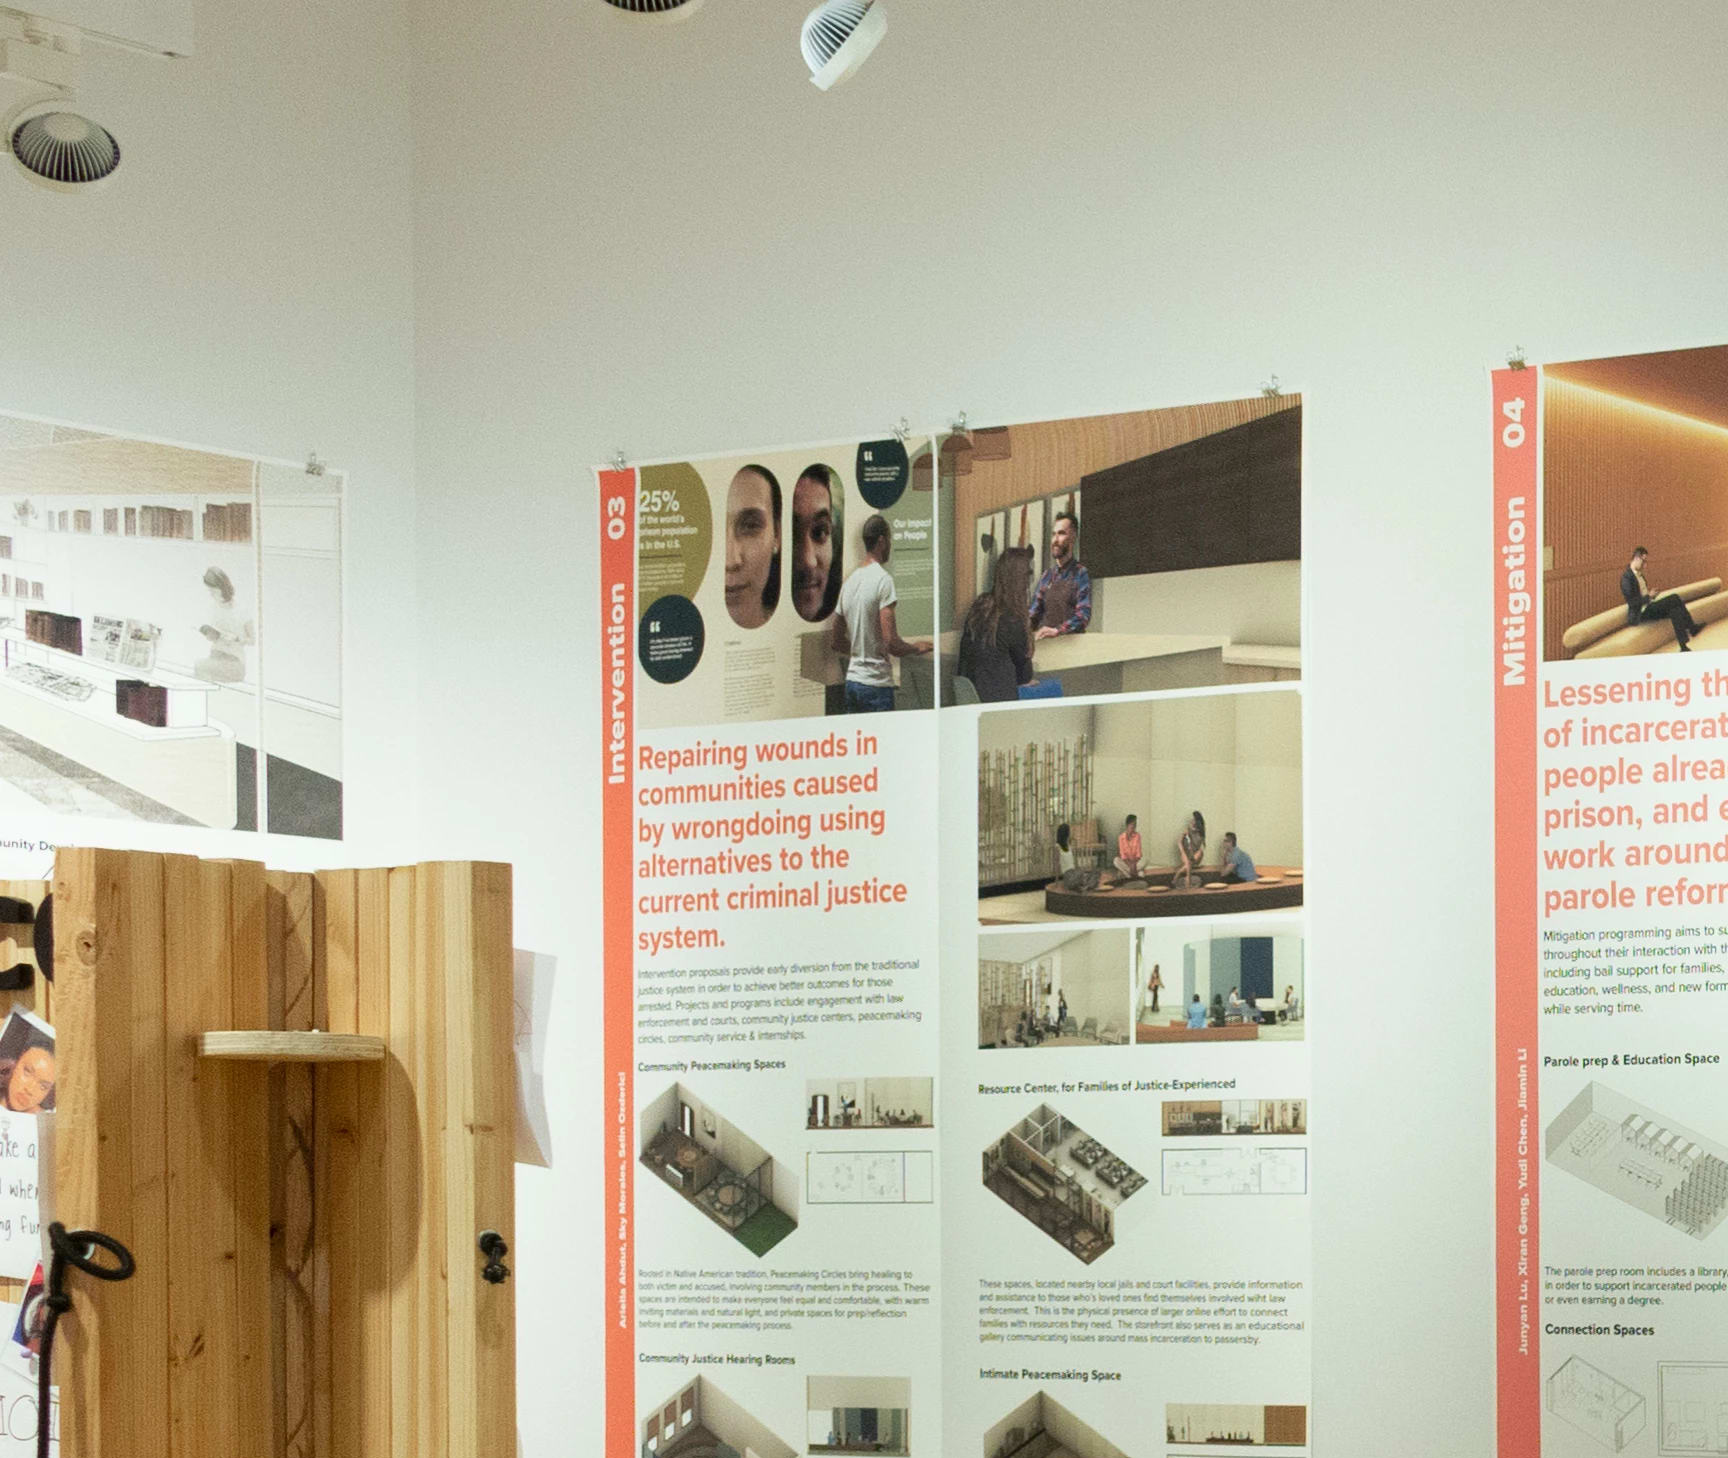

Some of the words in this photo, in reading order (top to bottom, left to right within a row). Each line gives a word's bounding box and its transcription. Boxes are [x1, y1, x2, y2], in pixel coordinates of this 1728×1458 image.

[1503, 397, 1525, 448] 04
[608, 496, 625, 539] 03
[639, 489, 680, 512] 25%
[1502, 497, 1530, 686] Mitigation
[608, 584, 625, 784] Intervention
[1544, 672, 1691, 708] Lessening
[1544, 719, 1573, 748] of
[639, 740, 747, 774] Repairing
[755, 732, 848, 762] wounds
[857, 730, 877, 755] in
[639, 775, 786, 806] communities
[793, 767, 878, 797] caused
[1544, 757, 1643, 796] people
[639, 818, 664, 847] by
[672, 808, 811, 844] wrongdoing
[820, 804, 885, 836] using
[1545, 799, 1642, 837] prison,
[1653, 794, 1708, 824] and
[639, 848, 772, 878] alternatives
[779, 848, 803, 871] to
[810, 844, 849, 869] the
[1544, 840, 1615, 870] work
[638, 888, 719, 914] current
[727, 881, 819, 910] criminal
[824, 878, 907, 912] justice
[1545, 880, 1635, 918] parole
[639, 926, 725, 956] system.
[638, 1062, 688, 1073] Community
[691, 1060, 751, 1072] Peacemaking
[754, 1059, 786, 1071] Spaces
[1544, 1056, 1579, 1067] Parole
[1583, 1058, 1608, 1069] prep
[1612, 1055, 1619, 1065] &
[1624, 1053, 1681, 1065] Education
[1685, 1053, 1720, 1066] Space
[978, 1084, 1021, 1094] Resource
[1062, 1082, 1075, 1092] for
[1078, 1081, 1119, 1092] Families
[1122, 1081, 1132, 1091] of
[1545, 1323, 1610, 1335] Connection
[1614, 1324, 1655, 1337] Spaces
[639, 1353, 689, 1365] Community
[692, 1354, 723, 1364] Justice
[726, 1354, 762, 1367] Hearing
[765, 1354, 795, 1365] Rooms
[980, 1368, 1019, 1379] Intimate
[1022, 1369, 1088, 1382] Peacemaking
[1091, 1370, 1121, 1382] Space
